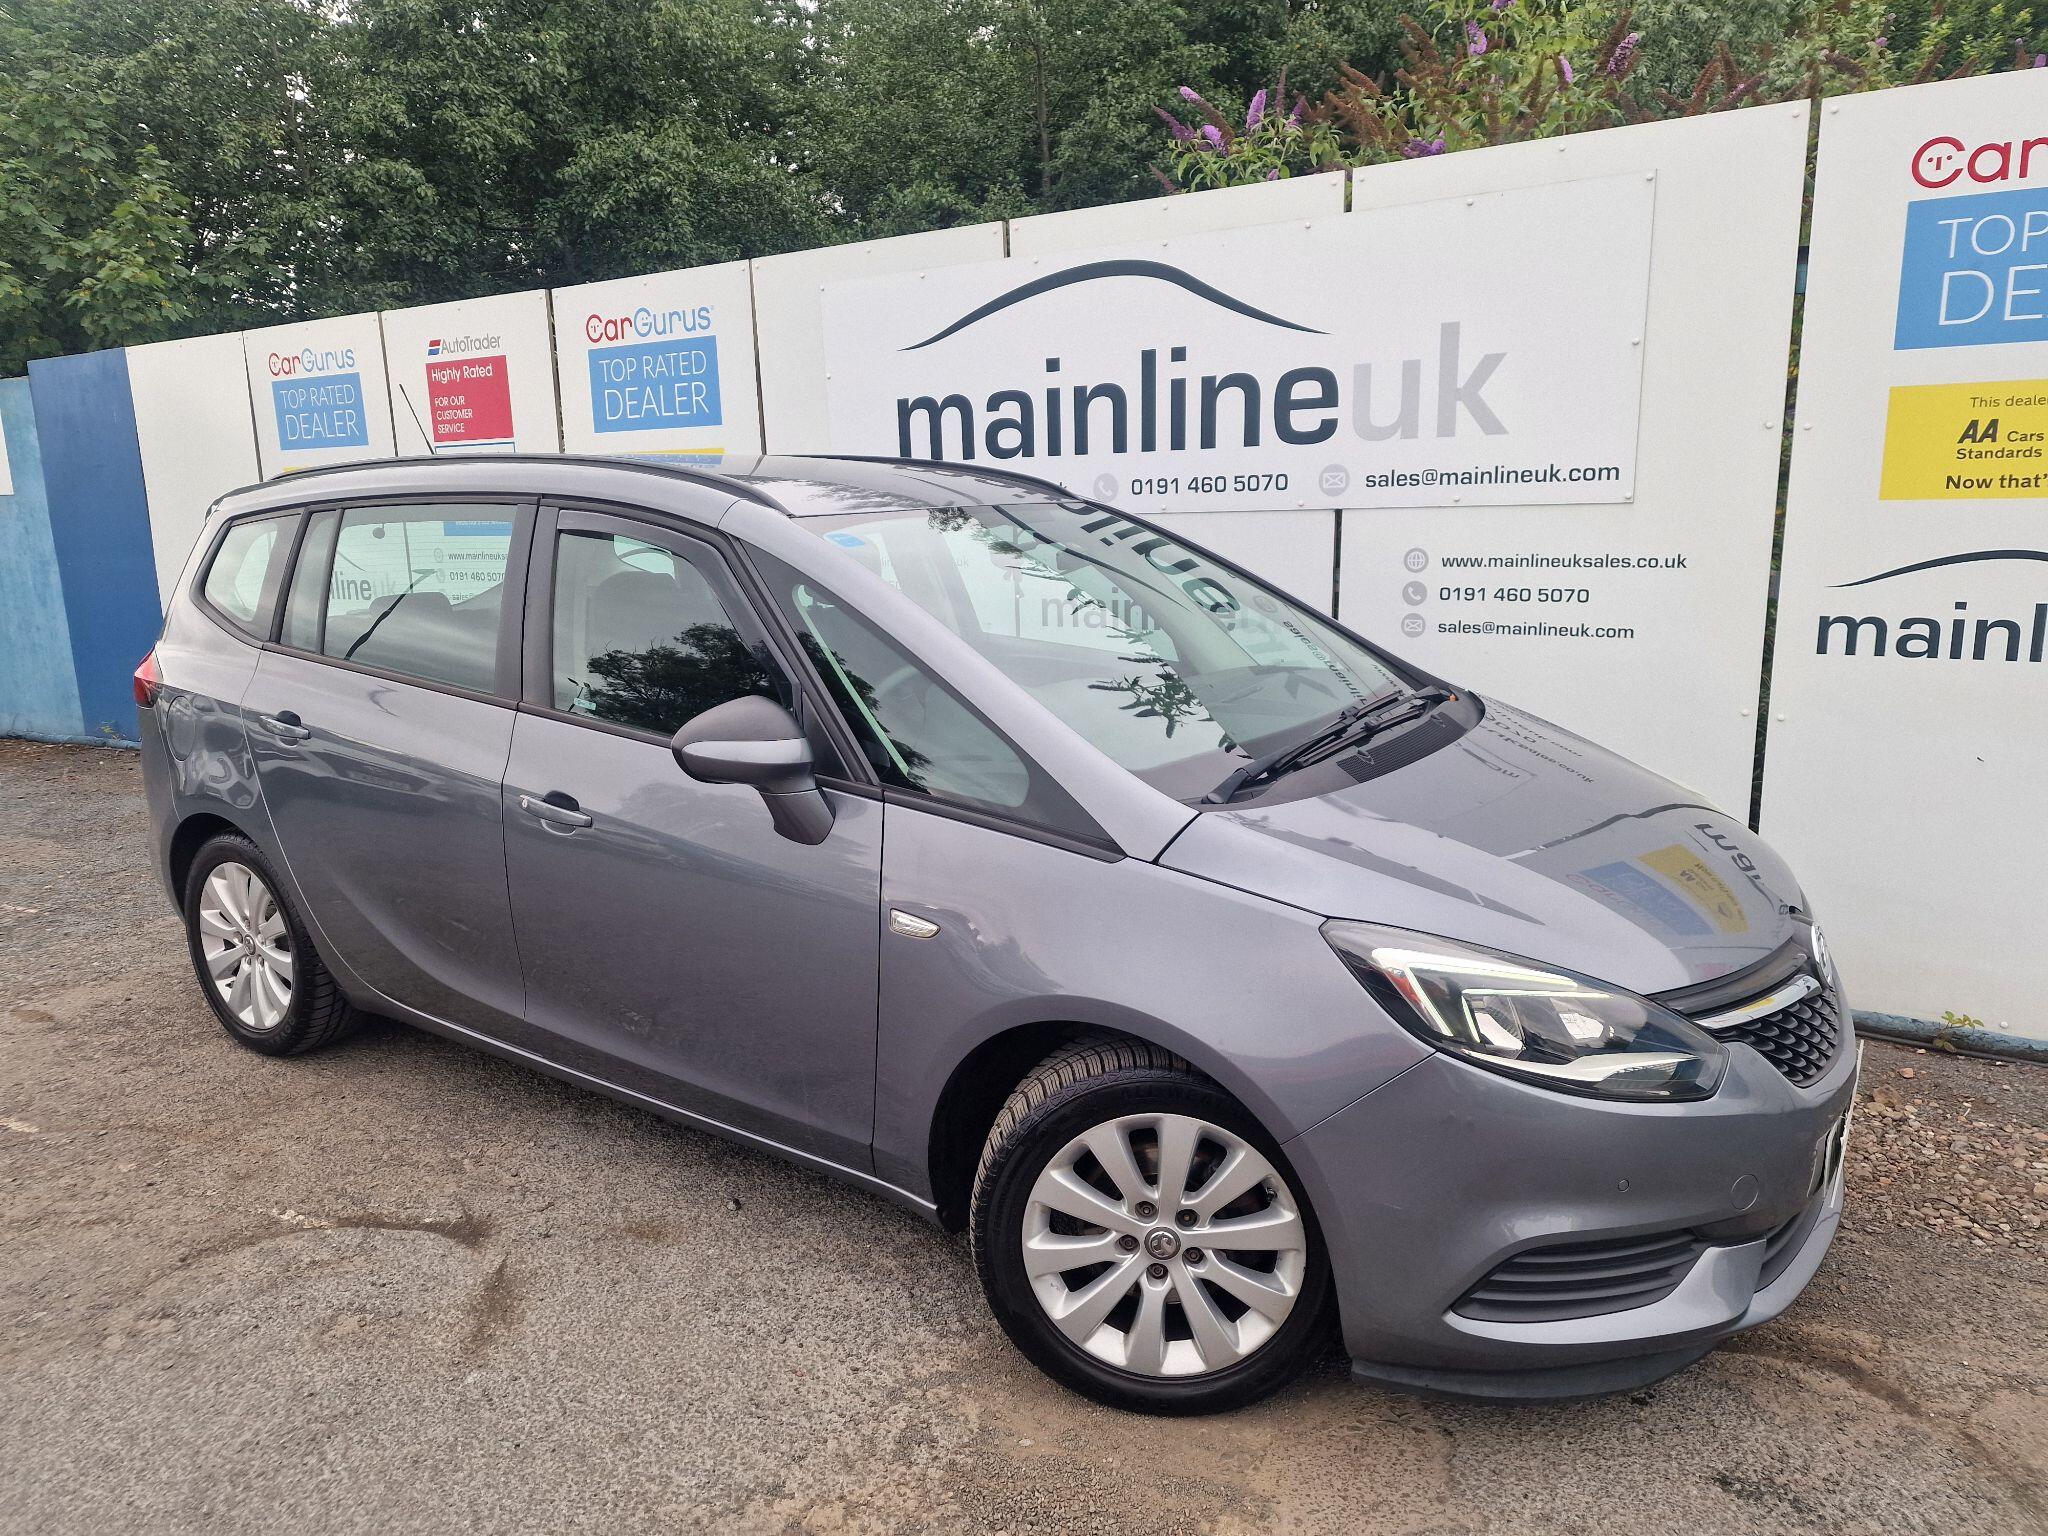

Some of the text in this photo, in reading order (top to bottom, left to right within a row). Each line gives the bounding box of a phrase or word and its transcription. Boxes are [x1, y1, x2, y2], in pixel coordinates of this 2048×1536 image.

[1937, 210, 2048, 258] TOP
[1938, 263, 2048, 325] DE
[586, 306, 712, 343] CarGurus
[440, 333, 501, 354] AutoTrader
[268, 348, 355, 376] CarGurus
[598, 350, 707, 382] TOP RATED
[431, 363, 493, 384] Highly Rated
[280, 384, 355, 409] TOP RATED
[434, 396, 465, 407] FOR OUR
[604, 382, 709, 420] DEALER
[1970, 394, 2048, 408] This deale
[285, 409, 360, 440] DEALER
[436, 409, 473, 420] CUSTOMER
[437, 423, 465, 434] SERVICE
[1957, 418, 2045, 443] AA Cars
[1956, 446, 2043, 459] Standards
[1131, 473, 1289, 495] 0191 460 5070
[1365, 463, 1620, 488] sales@mainlineuk.com
[1945, 475, 1993, 489] Now
[1441, 553, 1688, 570] www.mainlineuksales.co.uk
[1439, 586, 1590, 604] 0191 460 5070
[1438, 620, 1635, 639] sales@mainlineuk.com
[1816, 601, 2048, 663] mainl
